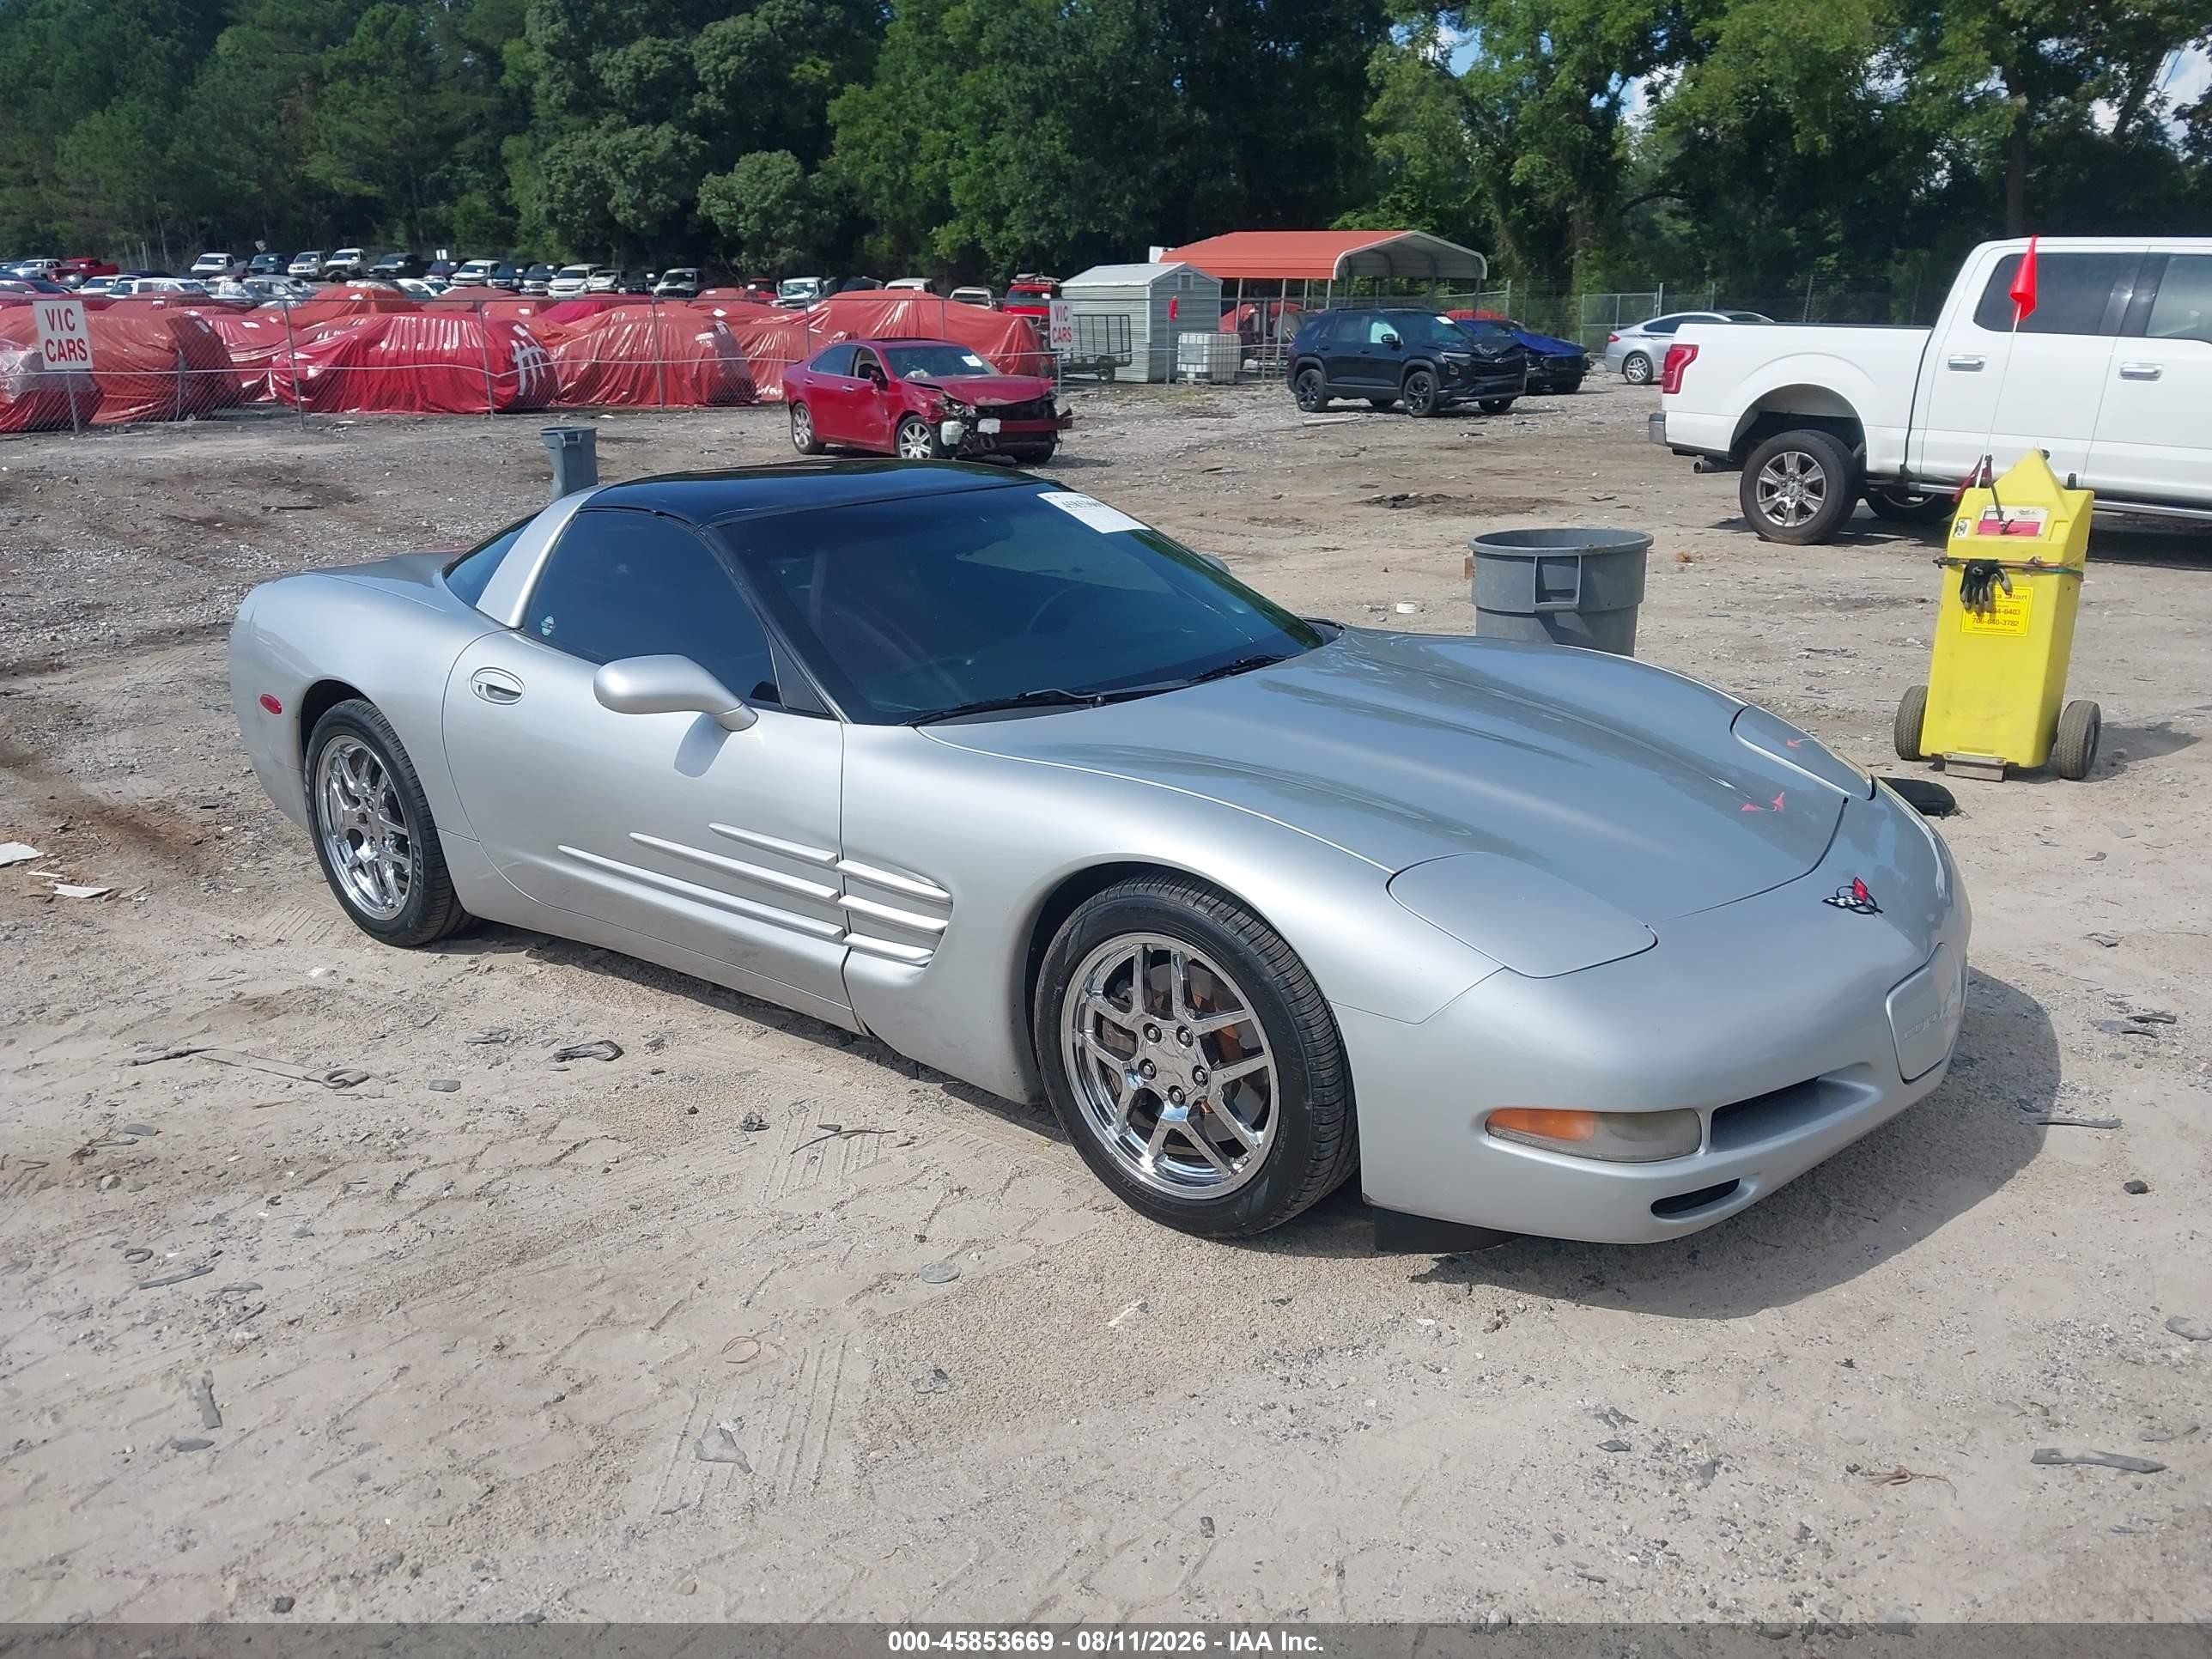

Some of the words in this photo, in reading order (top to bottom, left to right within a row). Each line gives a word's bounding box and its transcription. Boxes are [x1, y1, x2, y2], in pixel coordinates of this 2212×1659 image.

[45, 307, 76, 331] VIC
[1054, 306, 1068, 322] VIC
[1053, 326, 1073, 343] CARS
[45, 337, 88, 362] CARS
